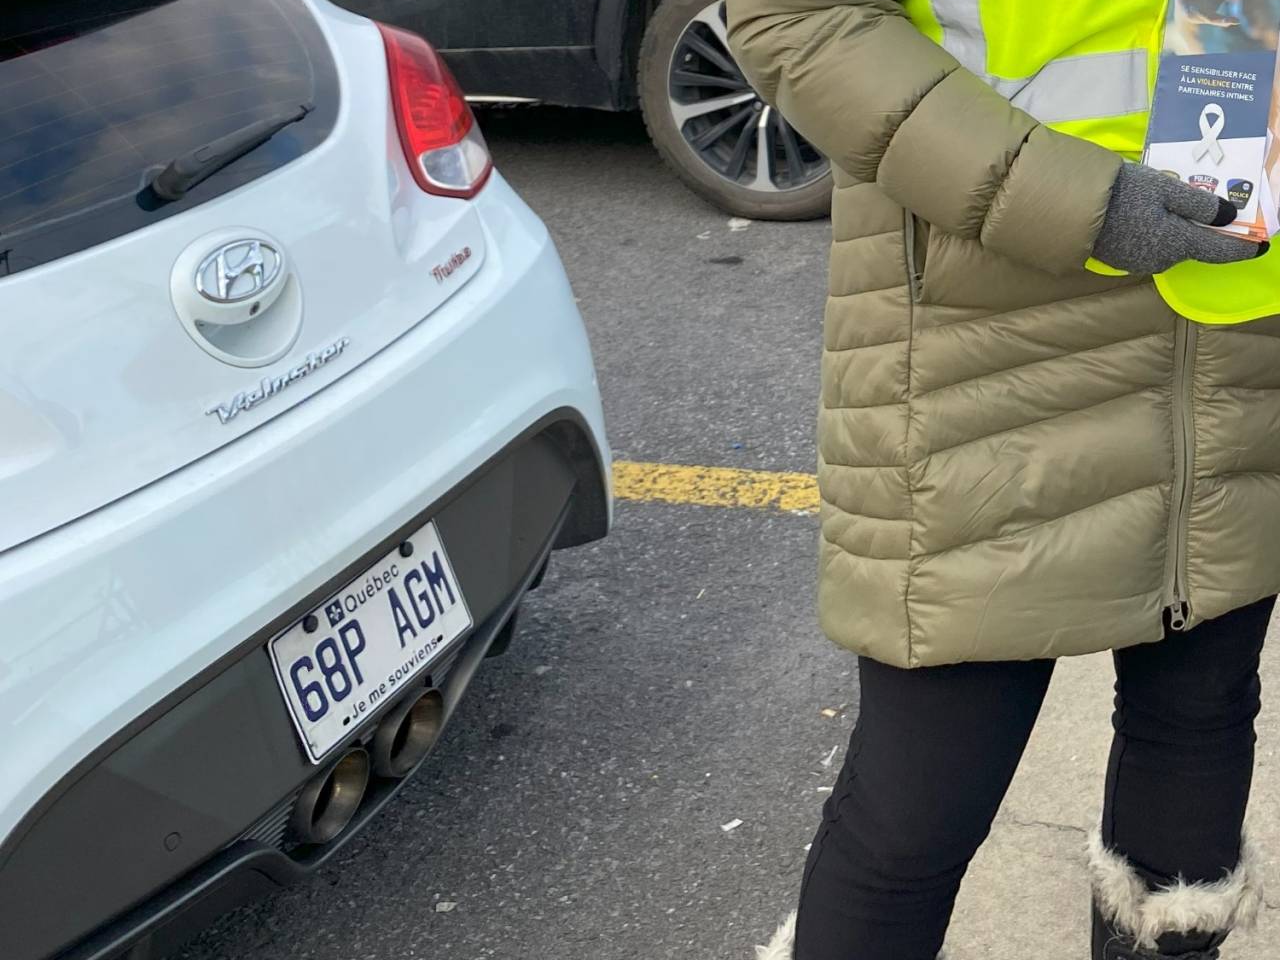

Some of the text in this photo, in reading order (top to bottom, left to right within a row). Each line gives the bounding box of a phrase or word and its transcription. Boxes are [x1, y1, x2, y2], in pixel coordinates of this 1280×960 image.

[1181, 65, 1257, 81] SE SENSIBILISER FACE
[1187, 76, 1196, 84] LA
[1197, 77, 1231, 88] VIOLENCE
[1231, 82, 1254, 91] ENTRE
[1178, 85, 1255, 102] PARTENAIRES INTIMES
[1229, 191, 1249, 199] POLICE
[343, 563, 400, 613] Québec
[289, 550, 456, 723] 68P AGM
[352, 639, 438, 720] Je me souviens
